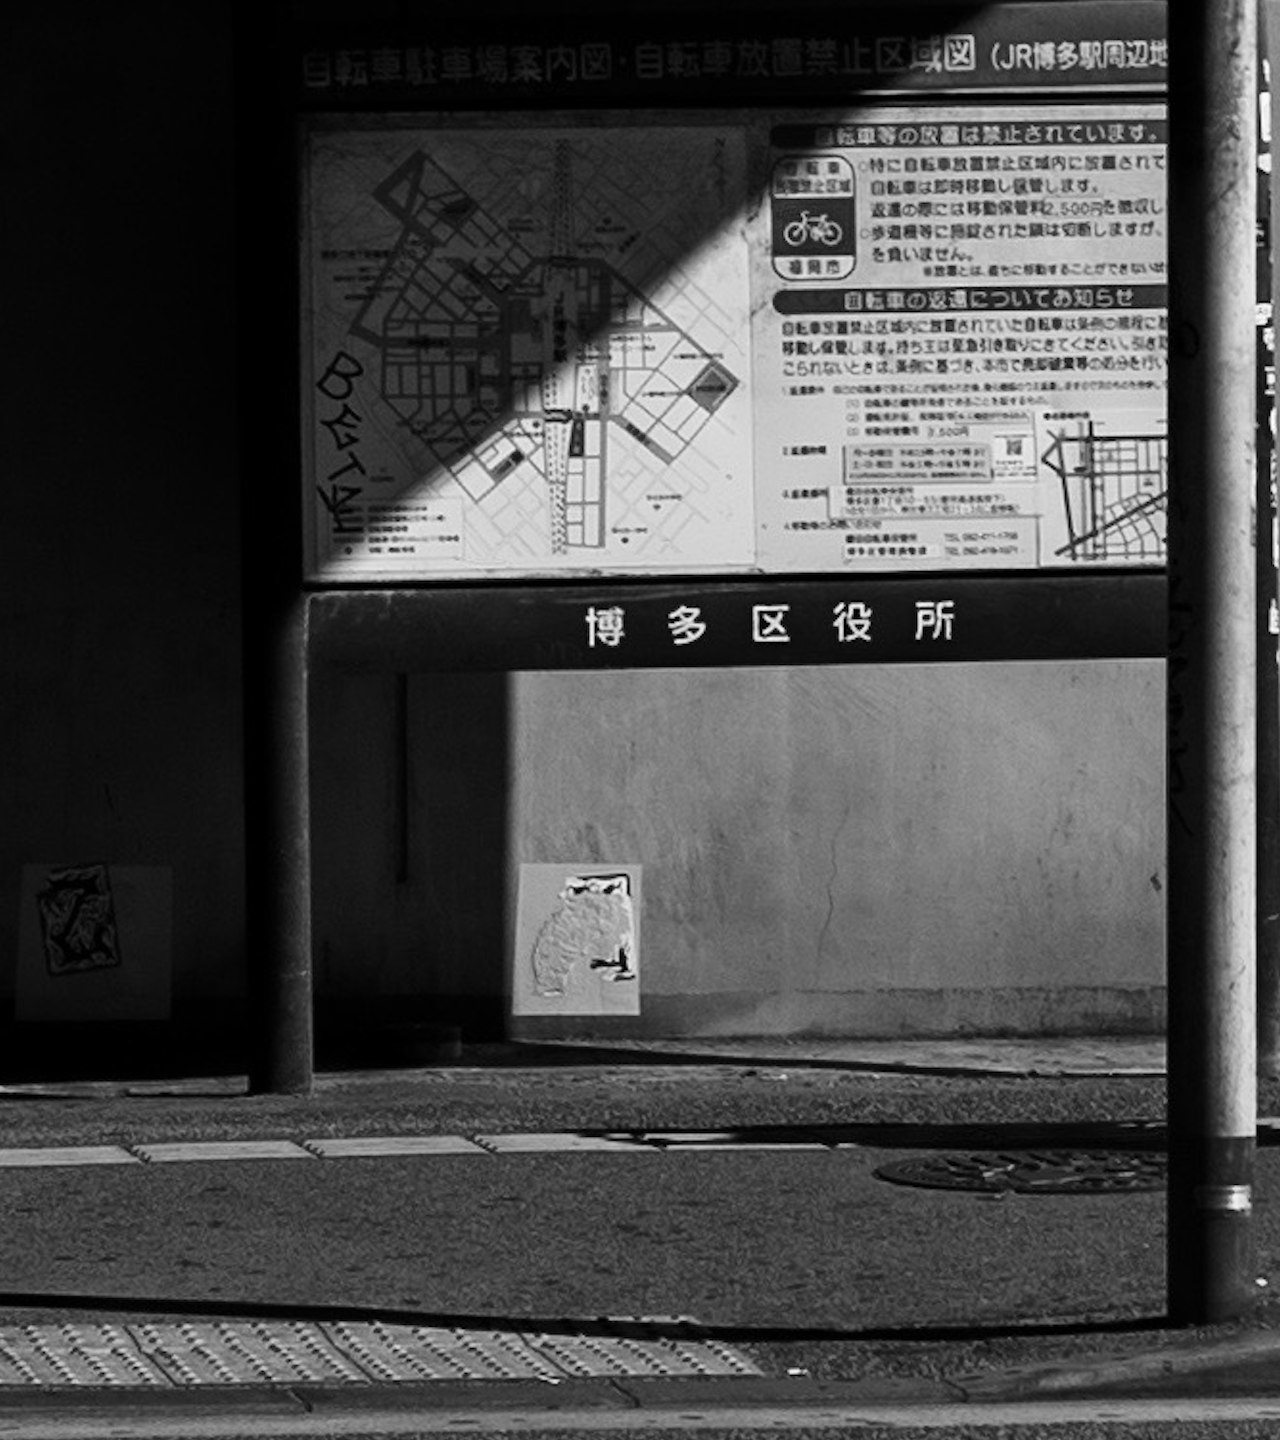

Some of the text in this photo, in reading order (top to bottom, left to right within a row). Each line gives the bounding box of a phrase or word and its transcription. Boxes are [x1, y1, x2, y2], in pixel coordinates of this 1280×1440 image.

[586, 601, 955, 647] 博多区役所
